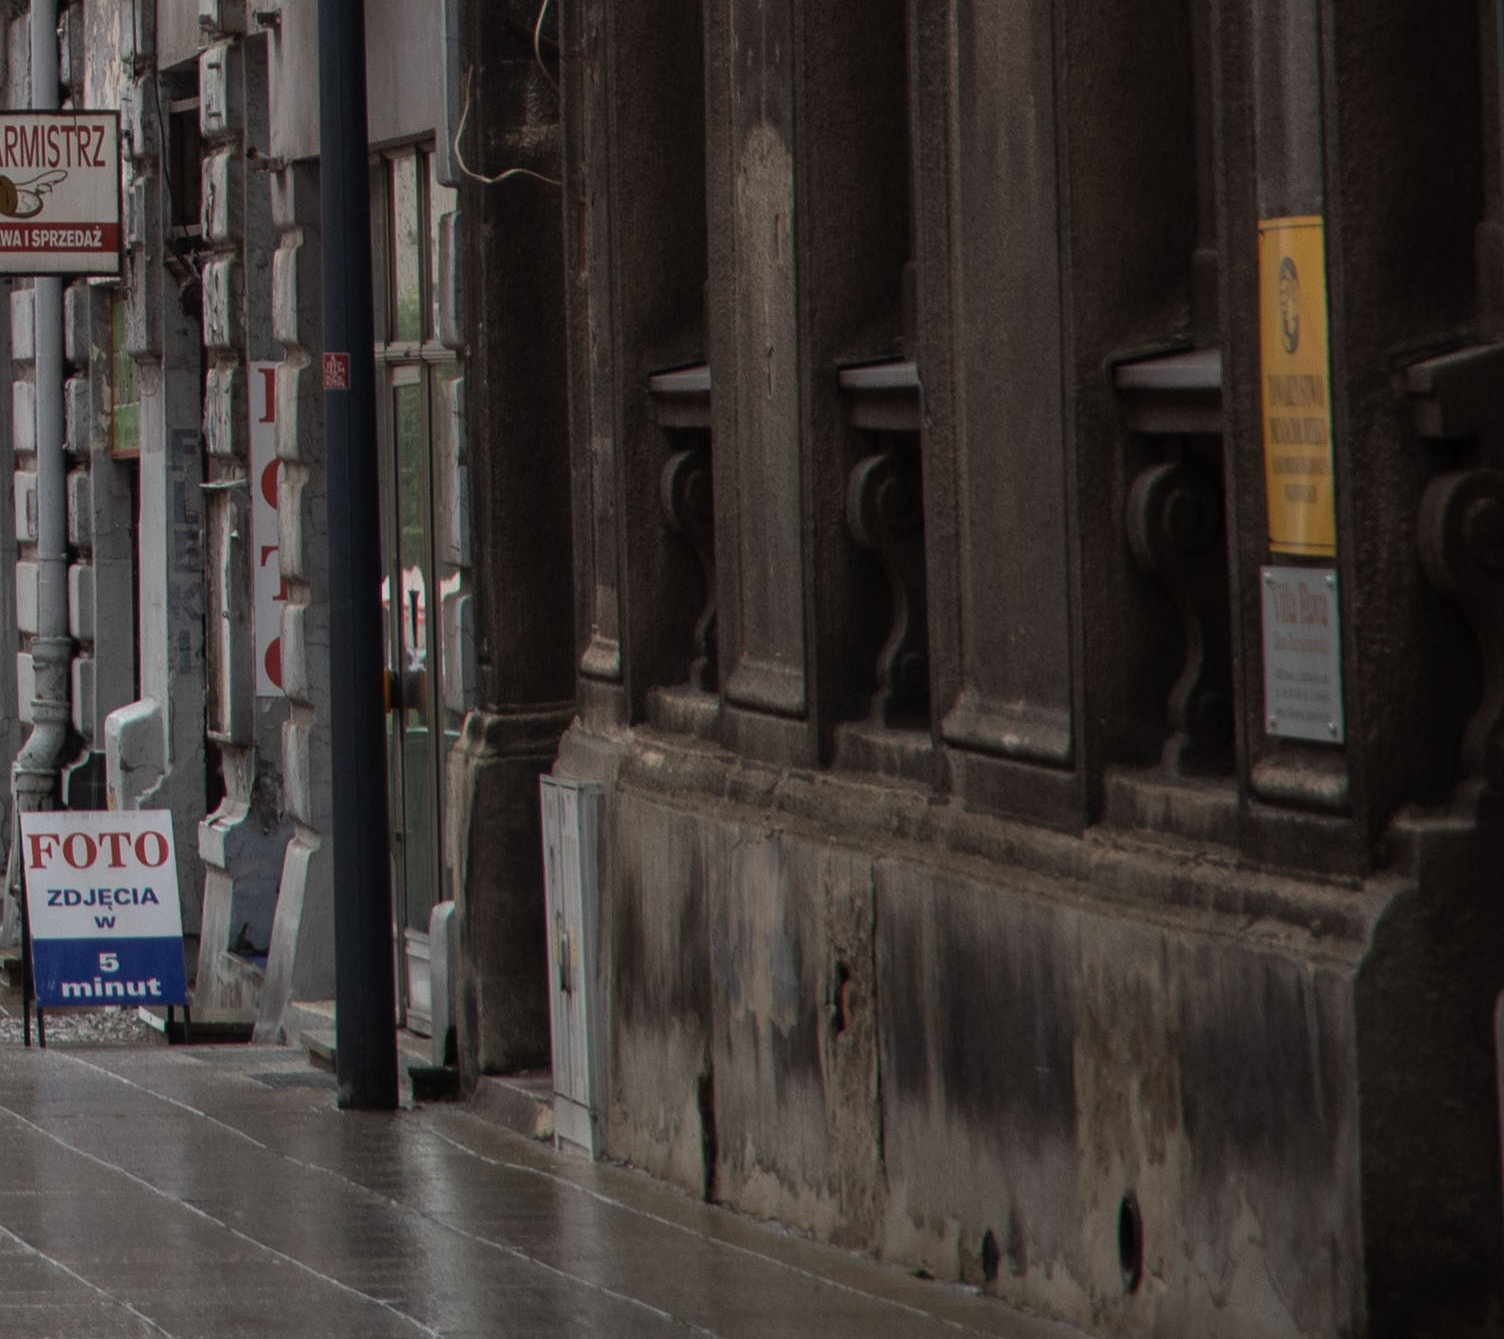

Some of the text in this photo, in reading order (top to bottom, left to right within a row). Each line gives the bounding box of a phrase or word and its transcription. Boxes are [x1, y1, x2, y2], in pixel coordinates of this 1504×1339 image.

[24, 230, 30, 247] I
[31, 225, 103, 247] SPRZEDAŻ
[26, 830, 169, 870] FOTO
[46, 887, 159, 911] ZDJĘCIA
[98, 952, 120, 973] 5
[60, 976, 162, 998] minut
